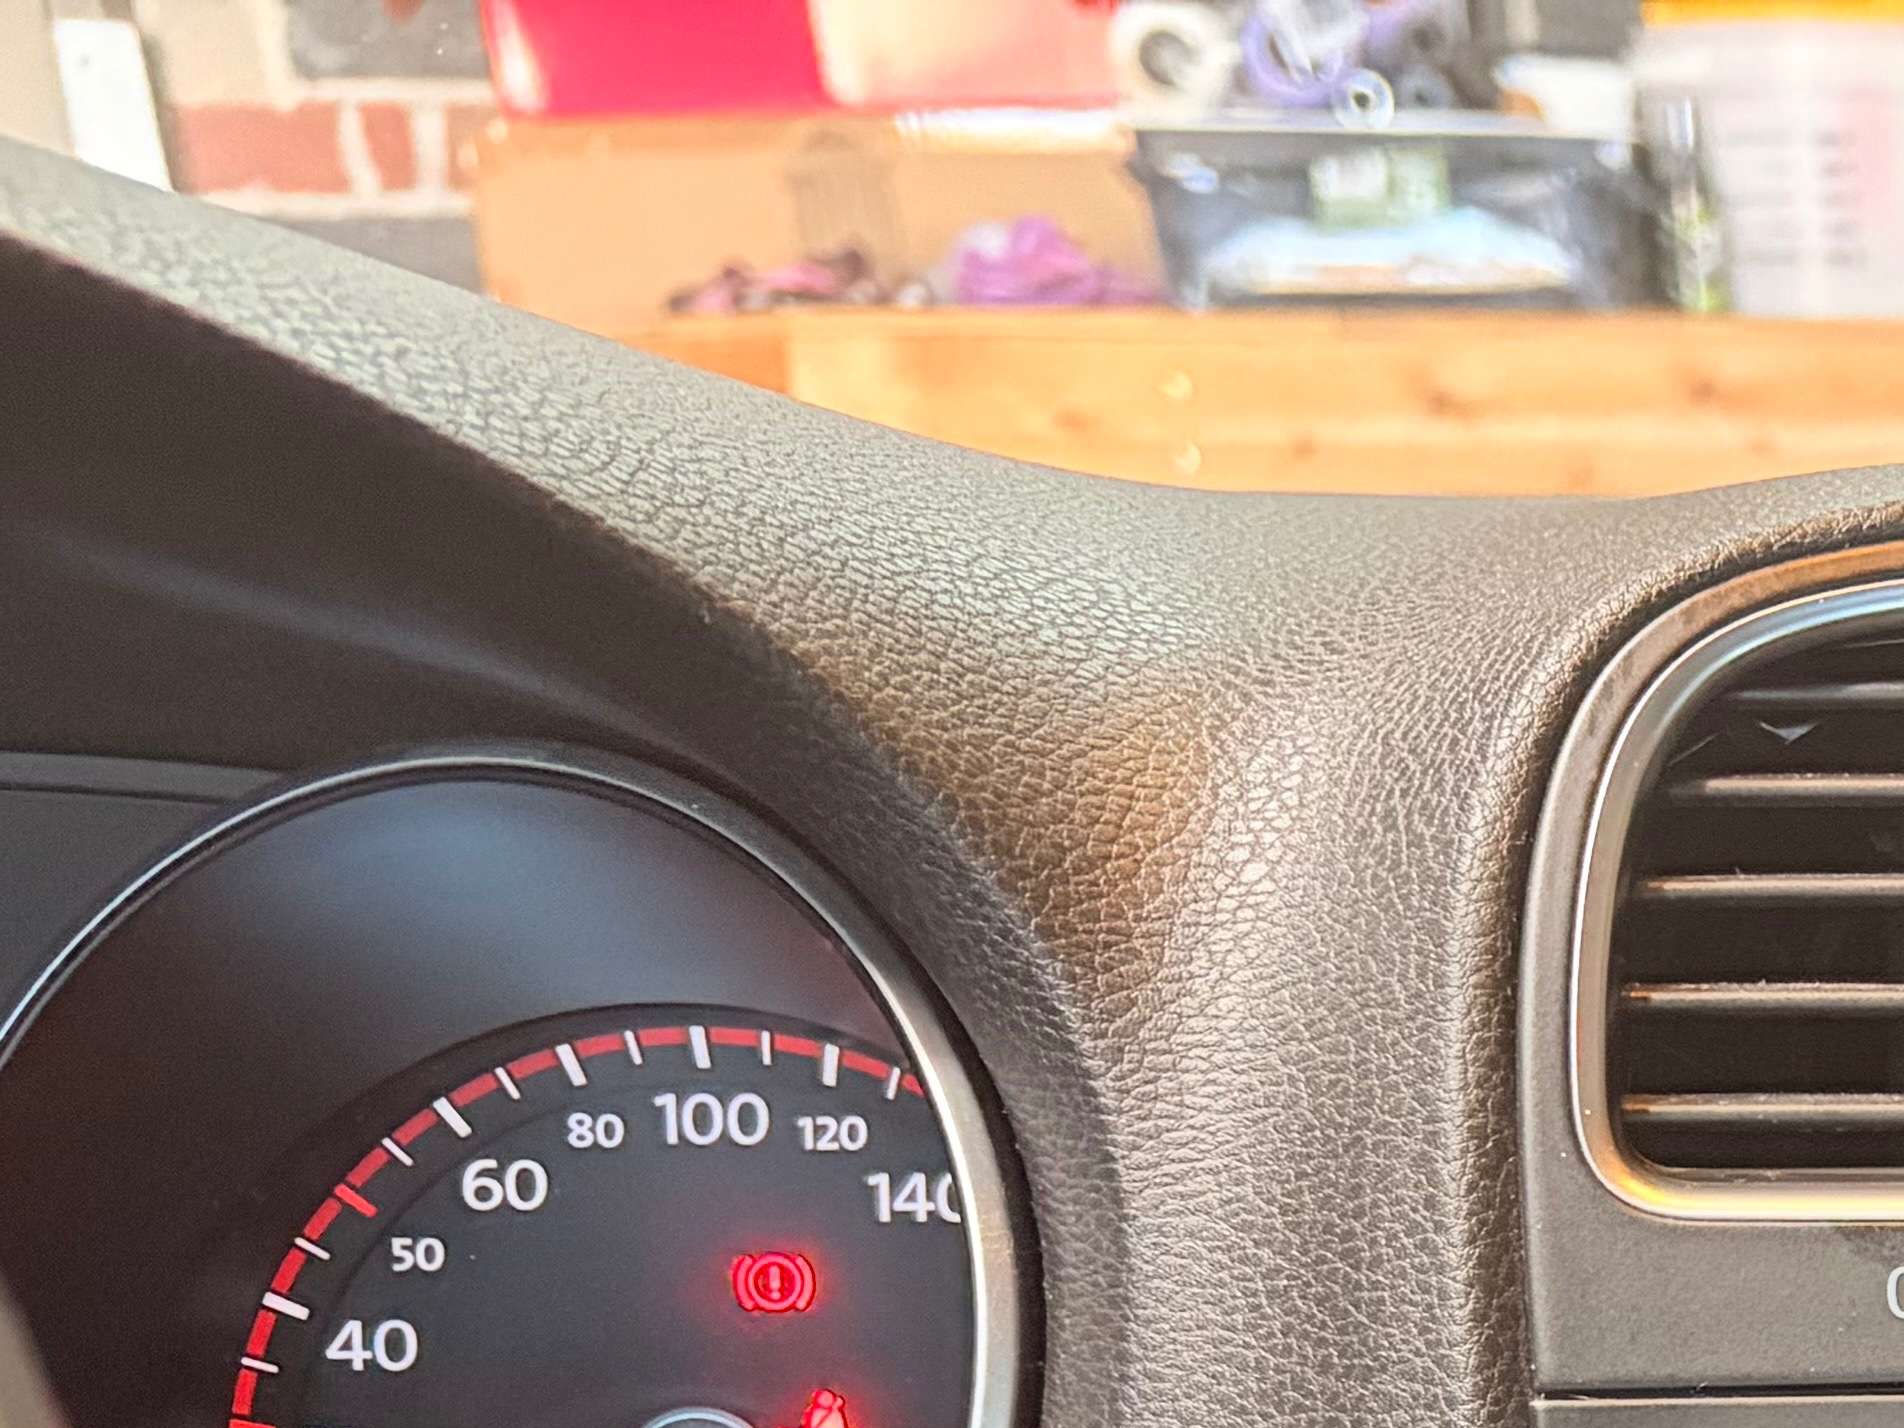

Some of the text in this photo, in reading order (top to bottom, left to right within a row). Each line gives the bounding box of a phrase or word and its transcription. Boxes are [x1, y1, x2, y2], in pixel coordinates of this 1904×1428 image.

[567, 1112, 625, 1148] 80
[653, 1092, 770, 1146] 100
[797, 1115, 868, 1151] 120
[462, 1159, 548, 1211] 60
[391, 1236, 445, 1272] 50
[325, 1319, 418, 1372] 40
